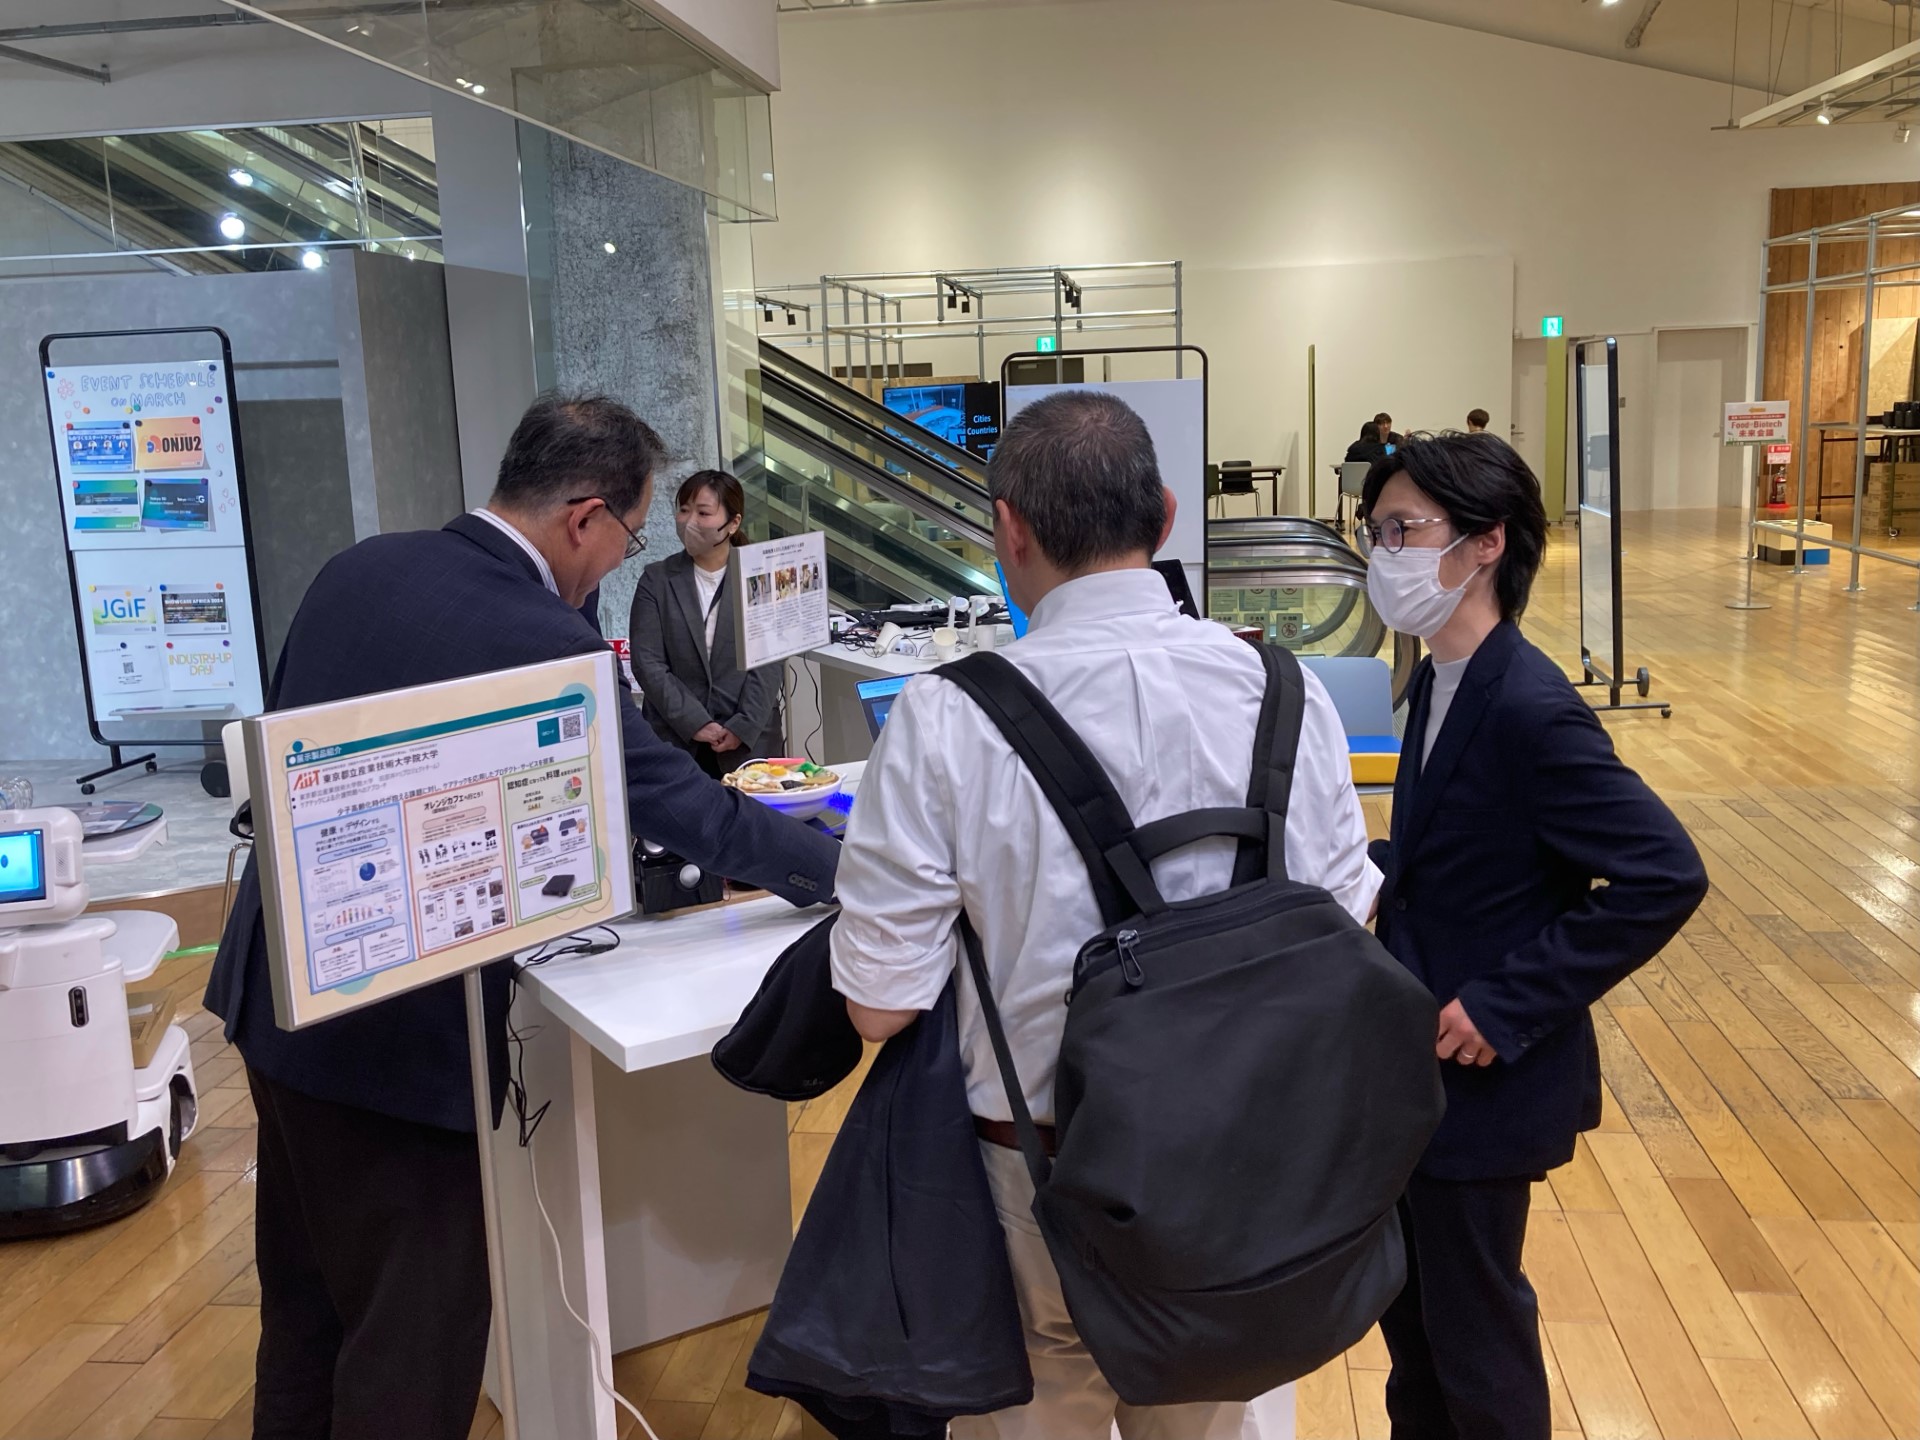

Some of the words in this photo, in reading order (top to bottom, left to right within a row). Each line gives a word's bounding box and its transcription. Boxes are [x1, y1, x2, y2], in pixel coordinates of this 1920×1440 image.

[81, 375, 132, 392] EVENT
[139, 371, 216, 389] SCHEDULE
[130, 392, 186, 408] MARCH
[973, 414, 991, 423] Cities
[967, 426, 998, 436] Countries
[1739, 429, 1774, 438] 未来会議
[168, 652, 232, 665] INDUSTRY-UP
[189, 665, 213, 676] DAY
[296, 745, 342, 764] 展示製品紹介
[323, 749, 439, 783] 東京都立産業技術大学院大学
